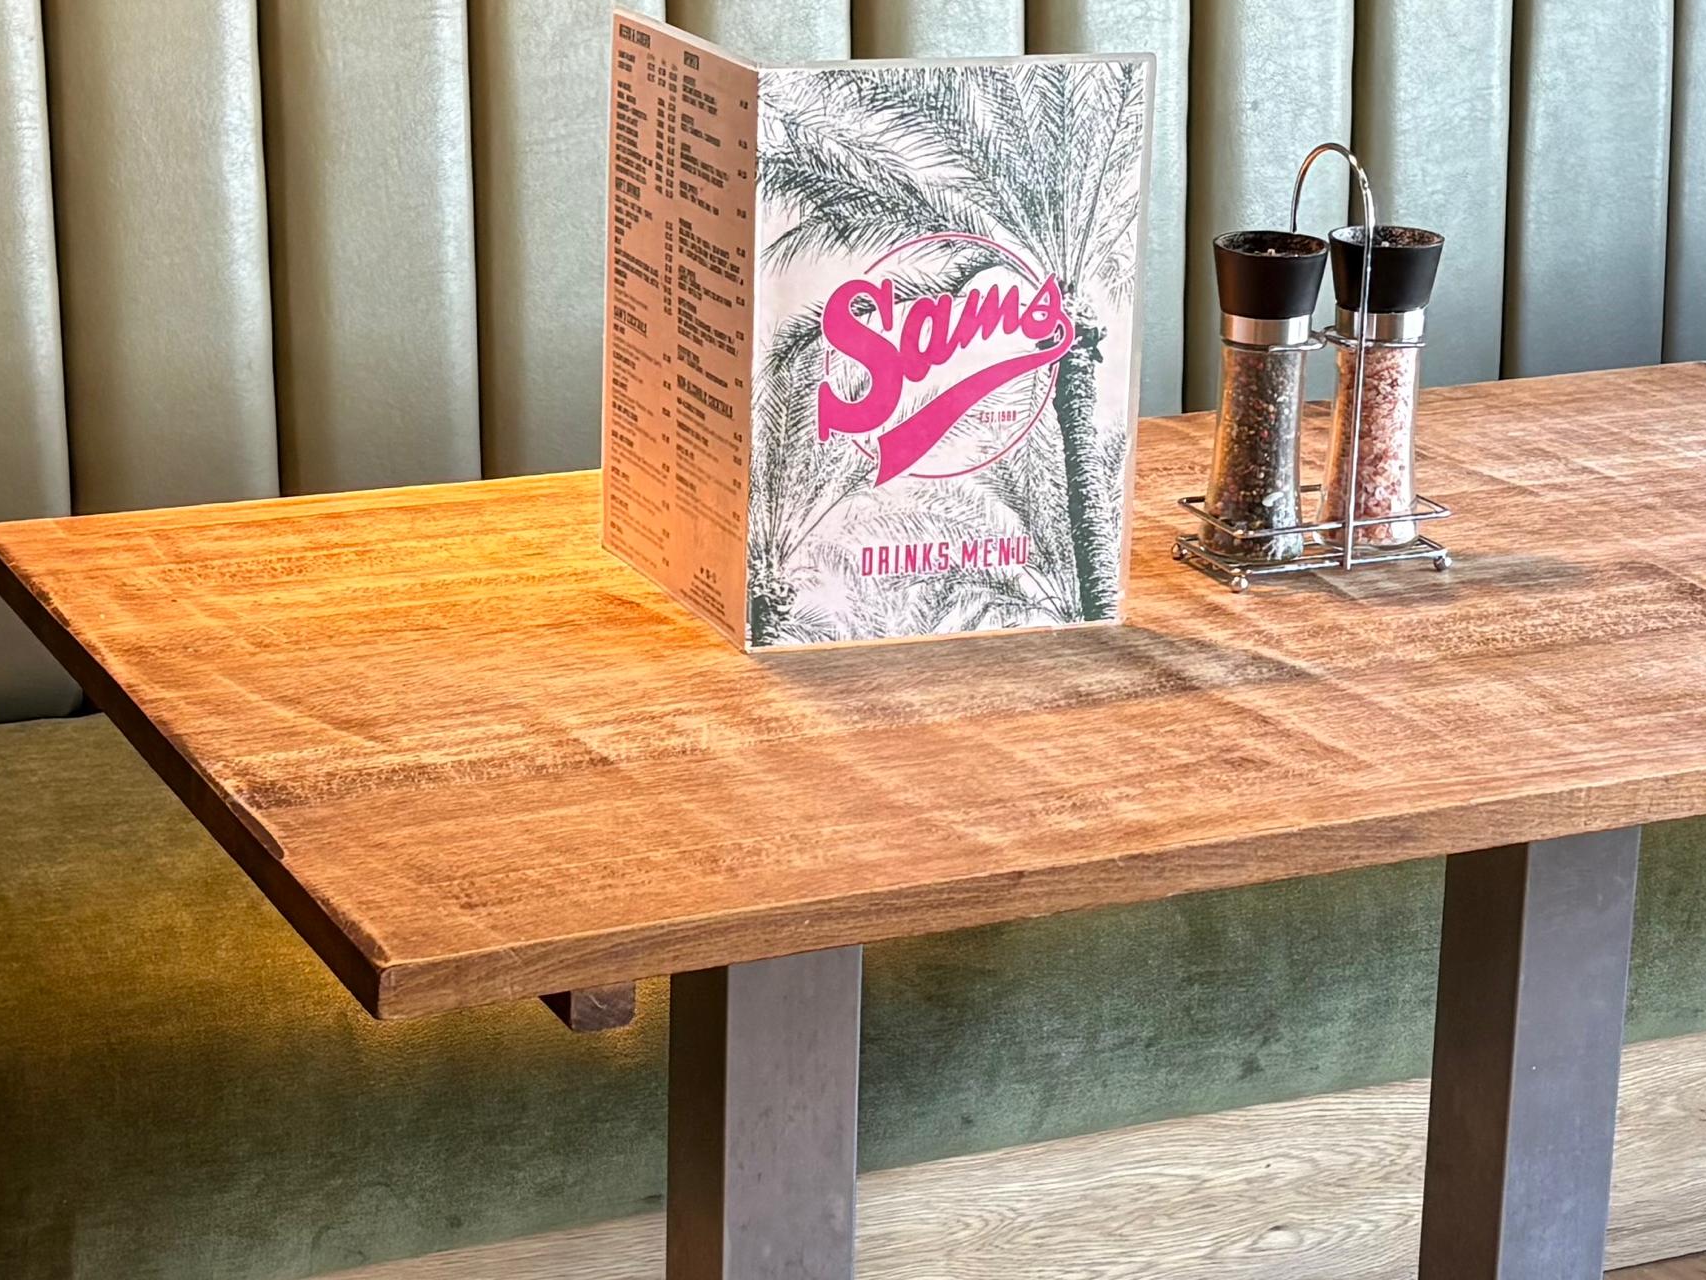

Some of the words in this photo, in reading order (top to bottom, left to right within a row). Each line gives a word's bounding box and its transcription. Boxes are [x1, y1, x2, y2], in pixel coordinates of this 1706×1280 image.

[817, 272, 1068, 444] Sams
[862, 542, 949, 577] DRINKS
[961, 535, 1029, 569] MENU
